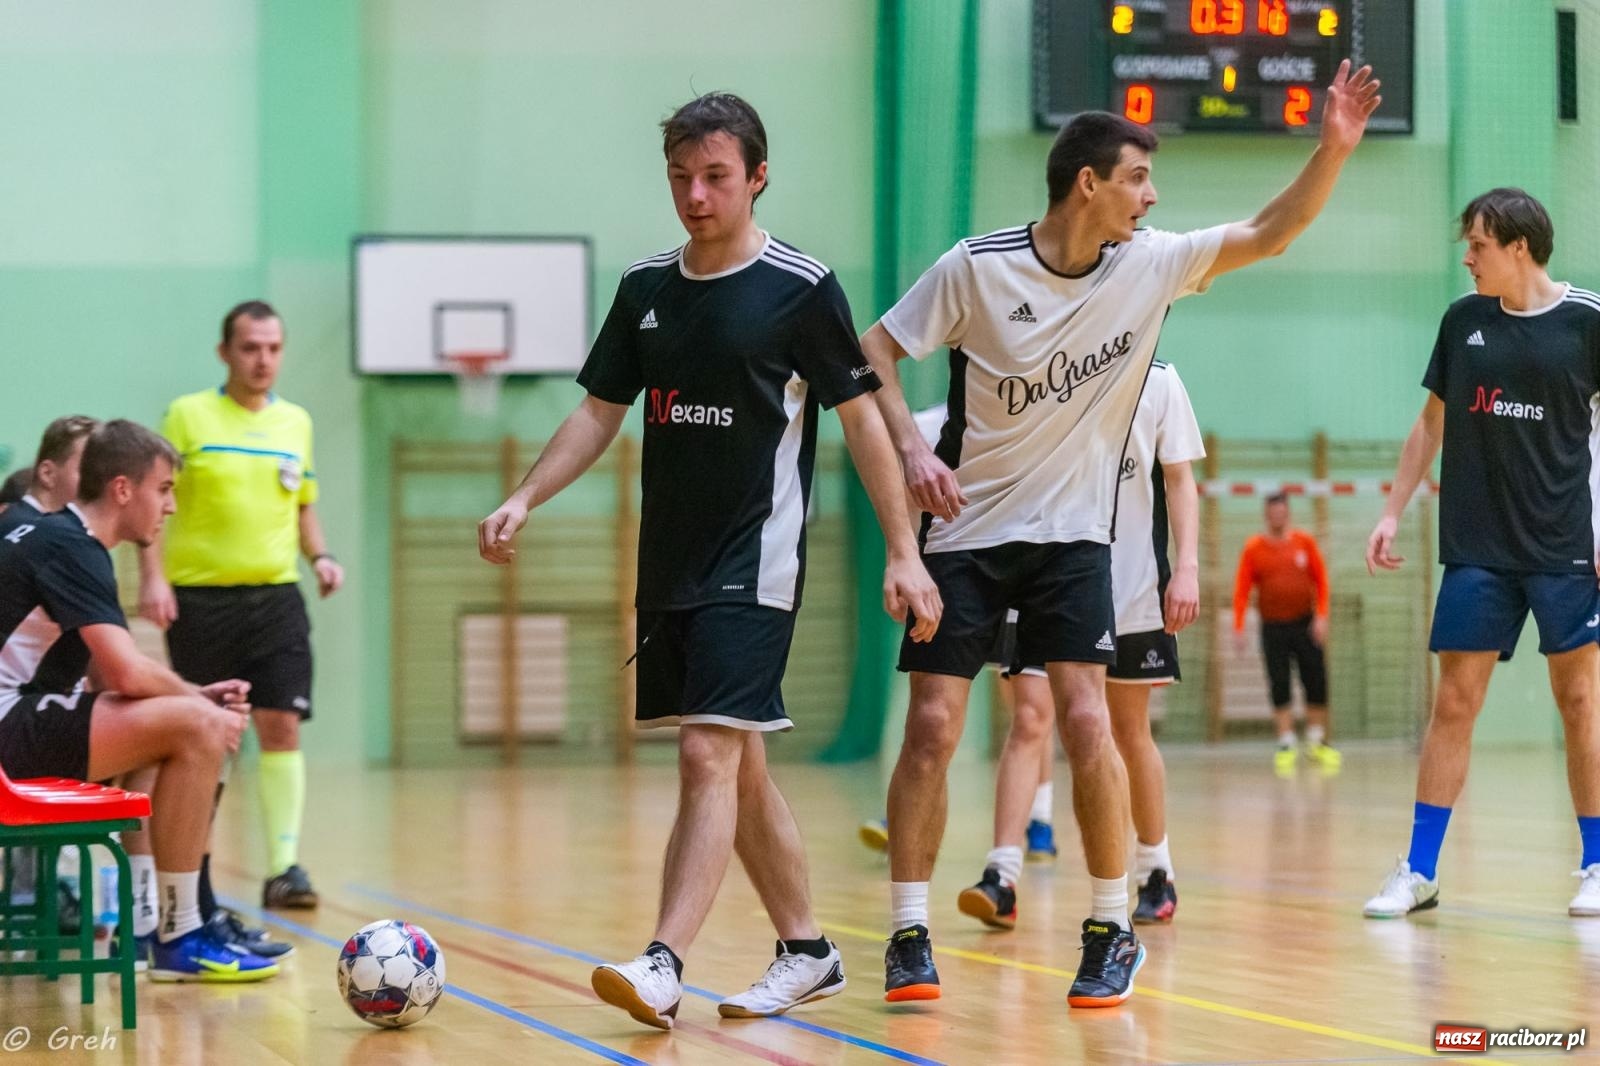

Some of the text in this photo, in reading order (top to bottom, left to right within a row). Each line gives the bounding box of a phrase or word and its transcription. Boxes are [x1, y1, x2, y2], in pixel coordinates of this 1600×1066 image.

[1284, 86, 1311, 126] 2
[640, 321, 659, 330] adidas
[1008, 314, 1037, 323] adidas
[647, 388, 734, 427] Nexans
[1468, 385, 1545, 421] Nexans
